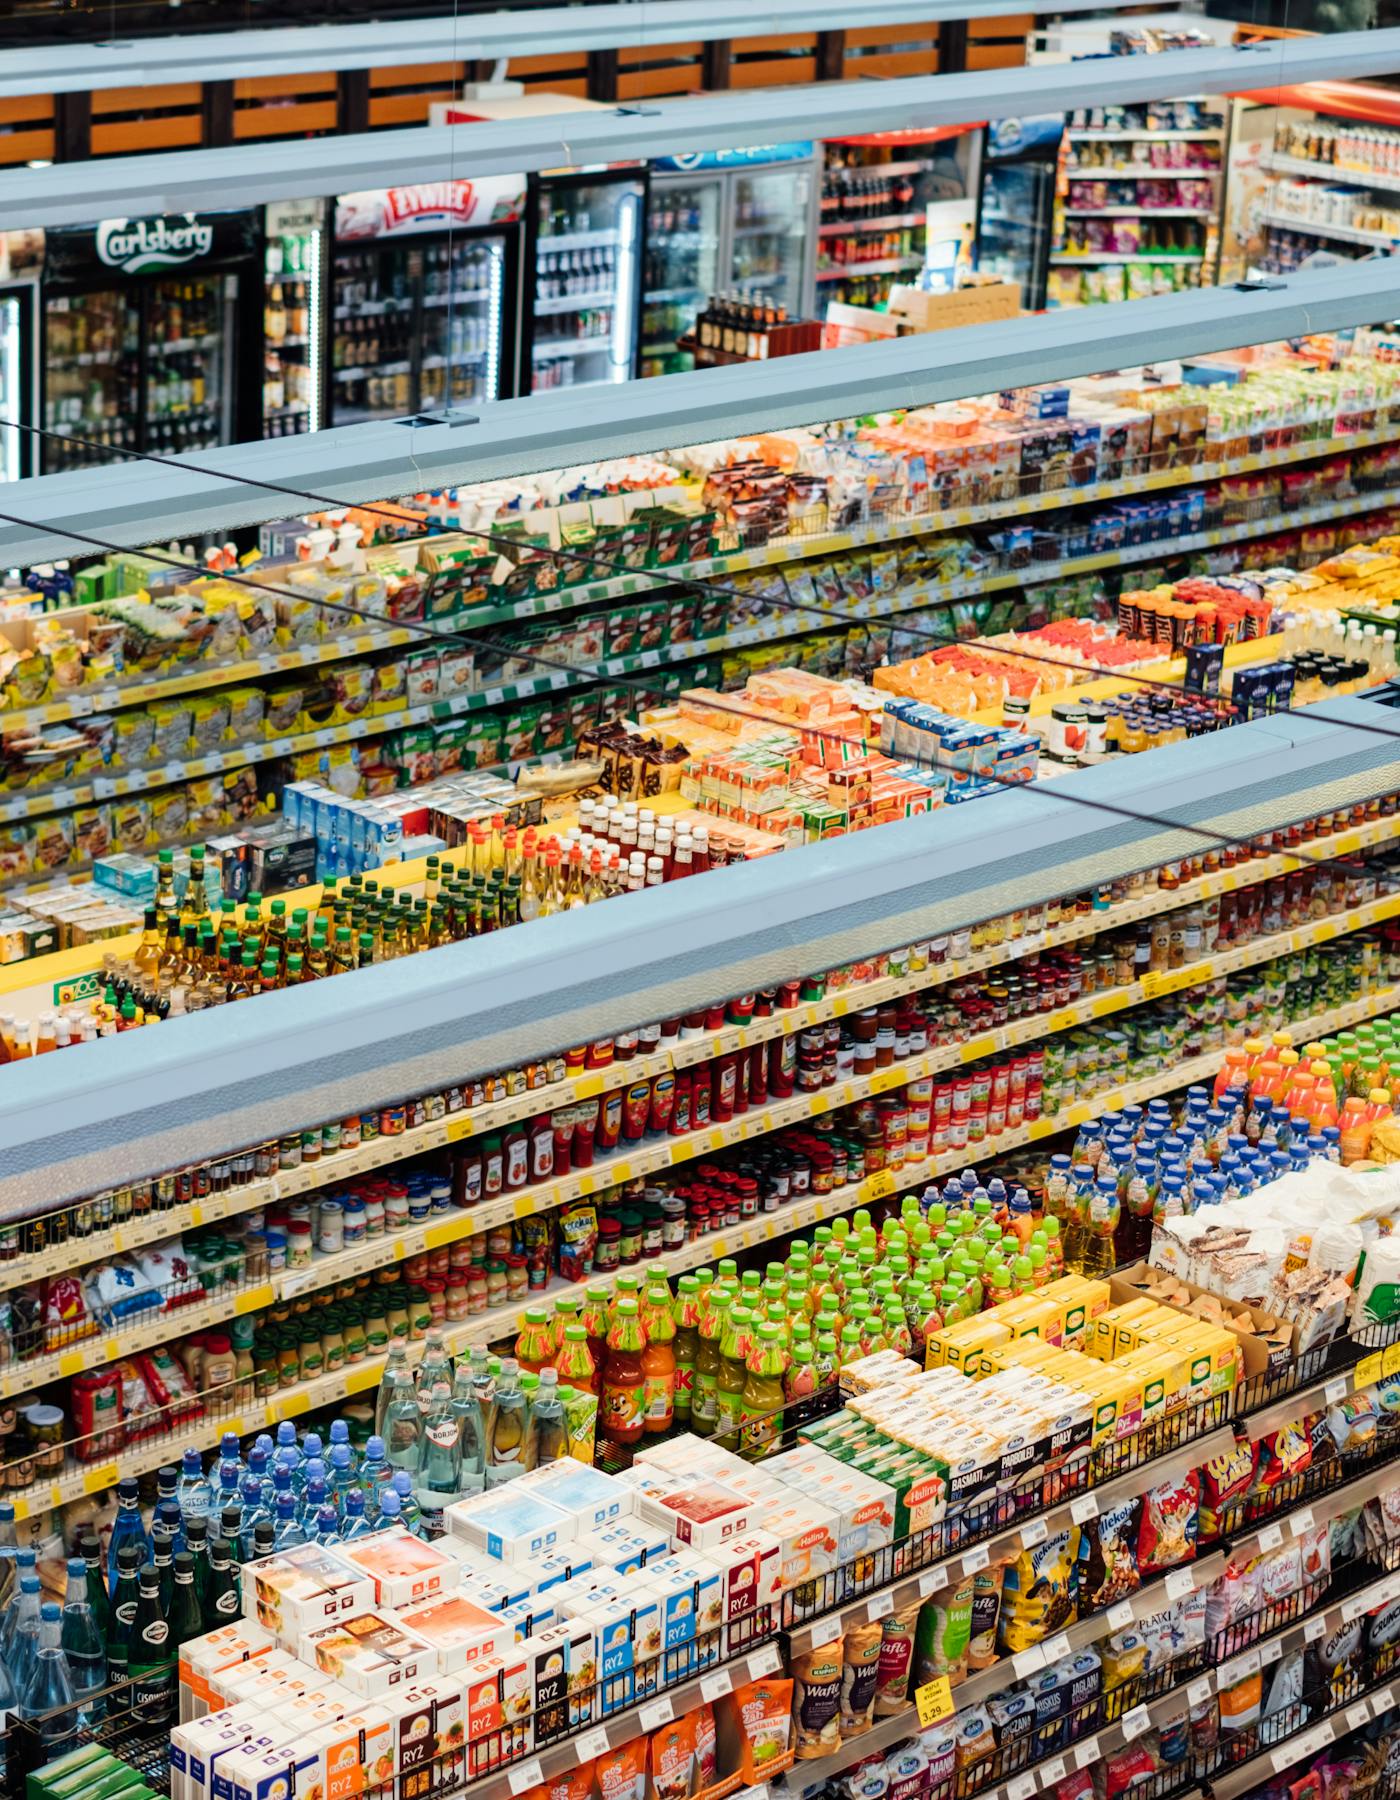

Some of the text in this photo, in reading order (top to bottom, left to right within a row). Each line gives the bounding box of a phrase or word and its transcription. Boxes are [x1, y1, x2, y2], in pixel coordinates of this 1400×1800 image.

[96, 217, 213, 267] Carlsberg
[584, 1313, 598, 1336] K
[686, 1303, 701, 1326] K
[703, 1313, 717, 1337] K
[738, 1335, 753, 1358] K
[559, 1353, 575, 1375] K
[750, 1351, 766, 1372] K
[675, 1368, 695, 1390] K
[1002, 1447, 1035, 1470] PARBOILED
[952, 1470, 983, 1491] BASMATI
[911, 1483, 938, 1503] Halina
[858, 1506, 881, 1521] Halina
[800, 1531, 825, 1547] Halina
[731, 1593, 749, 1613] RYŻ
[668, 1622, 687, 1642] RYŻ
[604, 1651, 624, 1672] RYŻ
[814, 1667, 838, 1676] KUPIEC
[538, 1681, 558, 1703] RYŻ
[807, 1682, 839, 1698] Wafle
[471, 1712, 492, 1733] RYŻ
[923, 1706, 942, 1723] 3,29
[402, 1744, 424, 1765] RYŻ
[330, 1776, 352, 1795] RYŻ
